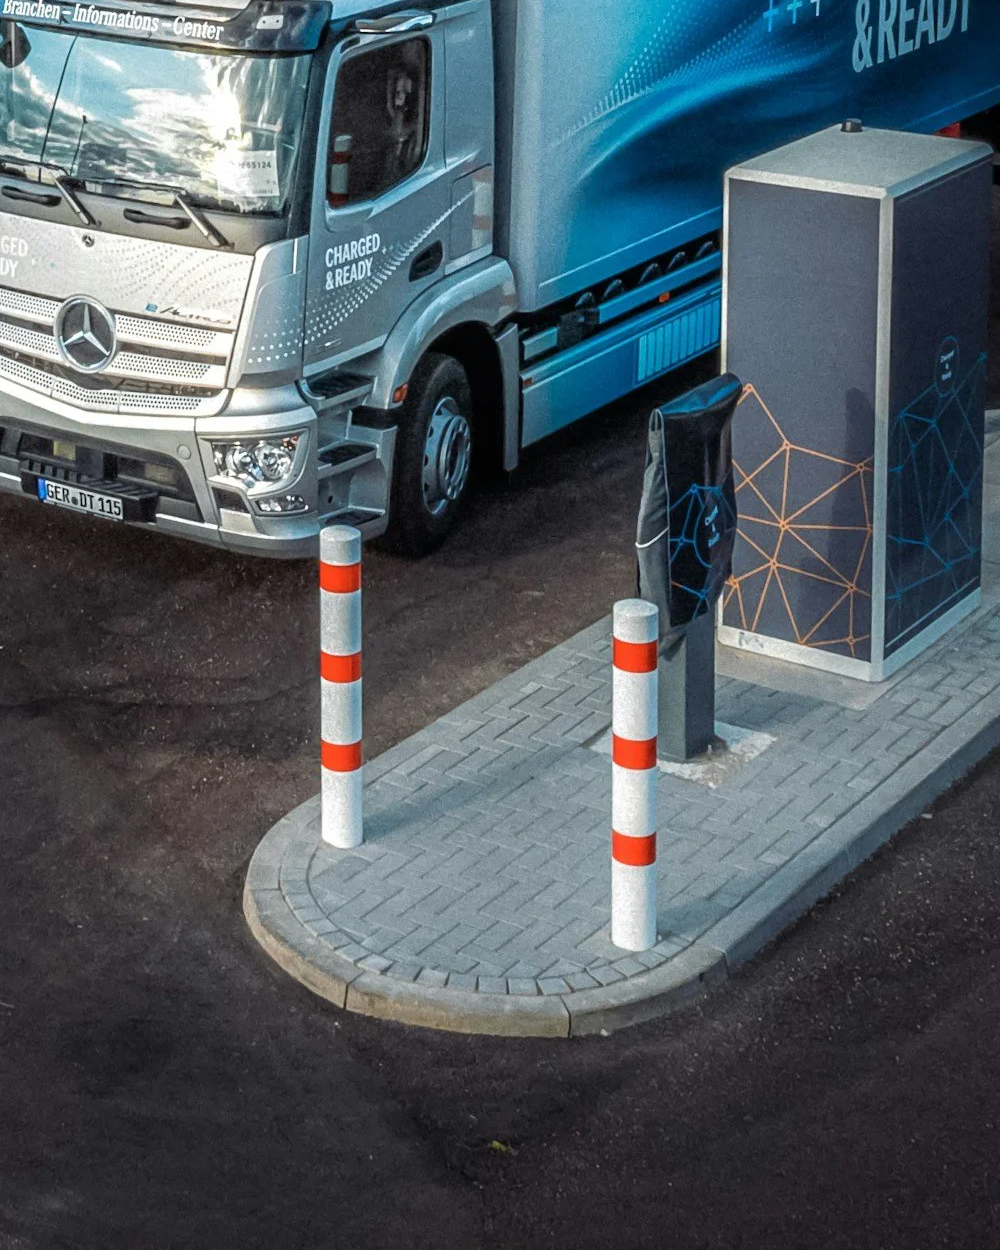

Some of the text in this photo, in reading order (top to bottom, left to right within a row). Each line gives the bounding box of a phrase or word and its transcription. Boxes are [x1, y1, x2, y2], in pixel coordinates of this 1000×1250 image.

[73, 3, 159, 32] Informations
[172, 16, 225, 41] Center
[325, 233, 380, 268] CHARGED
[46, 483, 121, 516] GER DT 115
